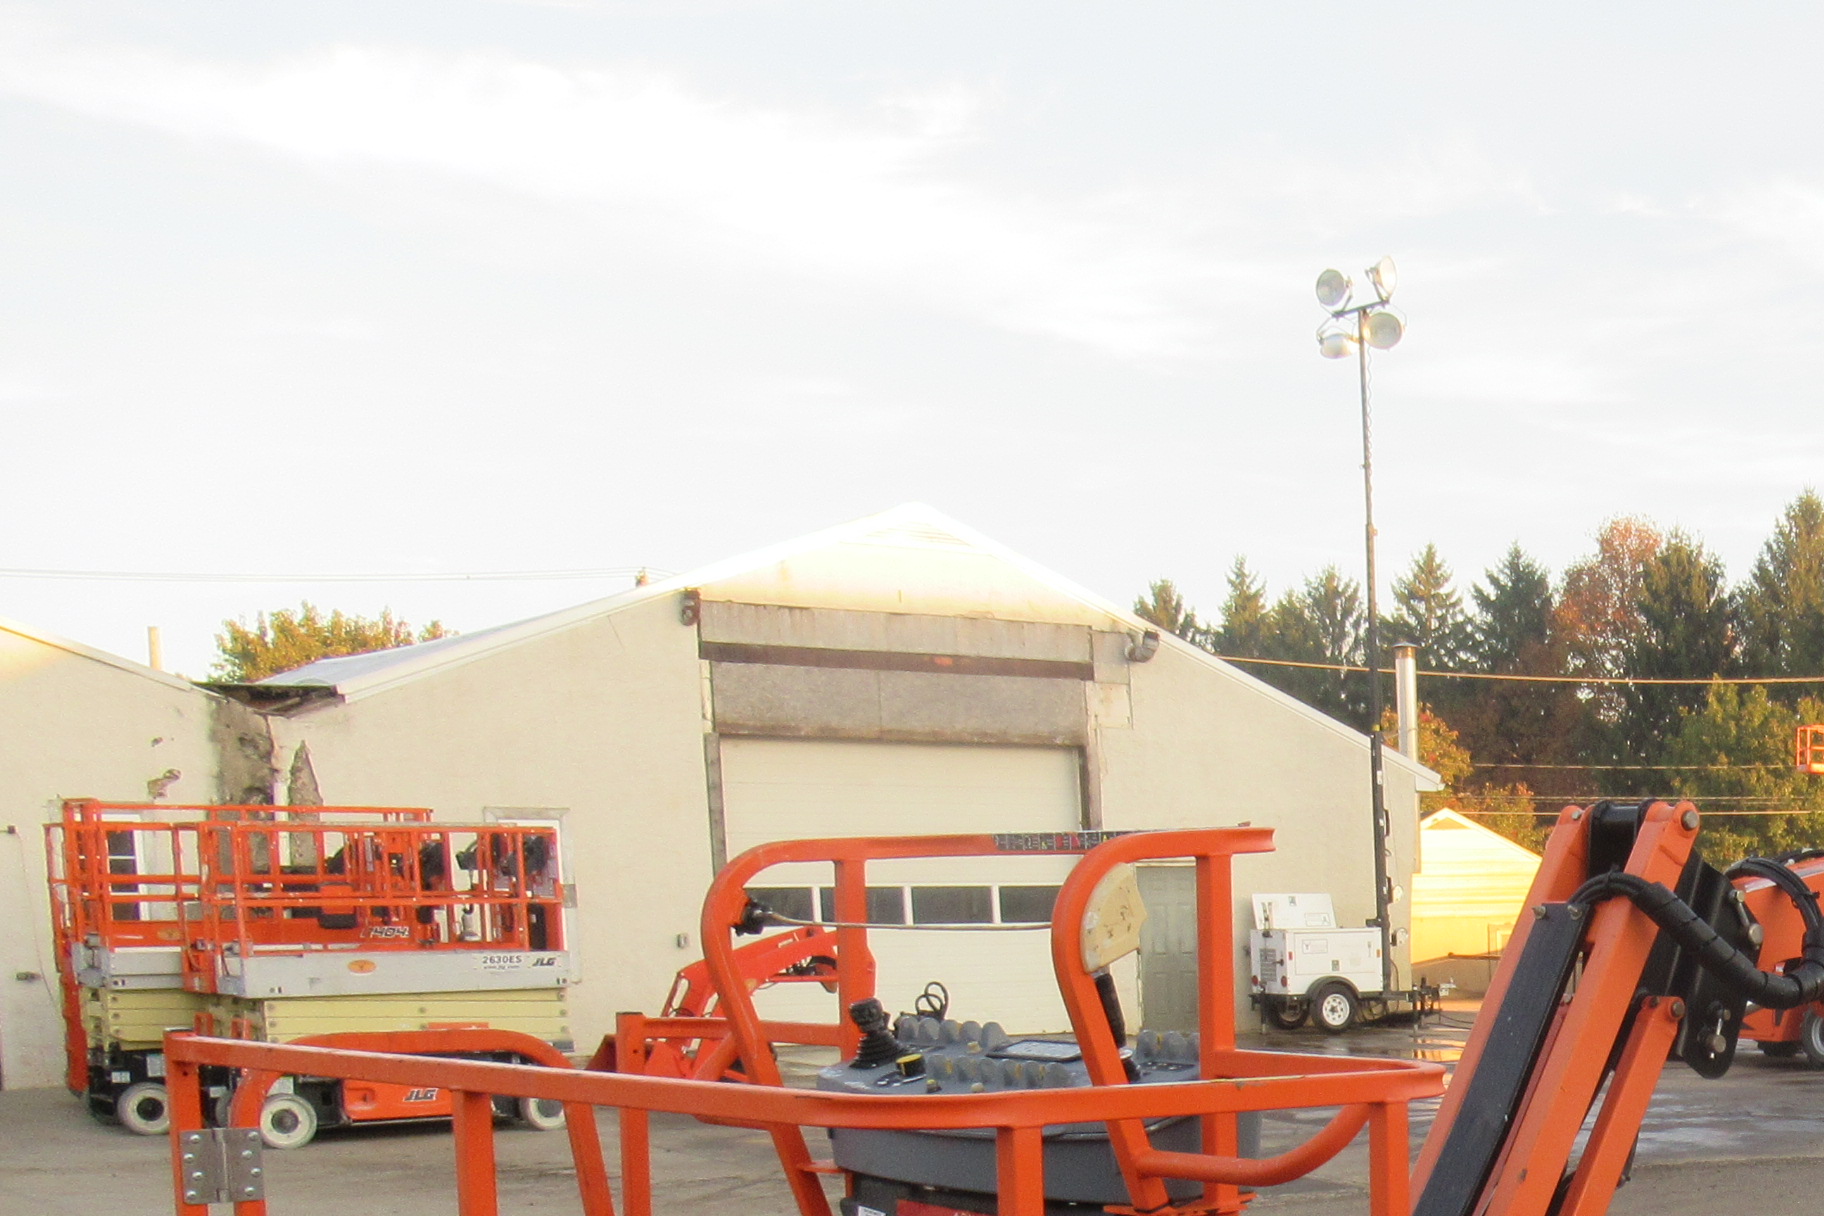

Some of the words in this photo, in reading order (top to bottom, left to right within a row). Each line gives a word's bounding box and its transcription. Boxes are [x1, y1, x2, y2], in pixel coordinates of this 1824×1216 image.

[482, 955, 522, 964] 2630ES
[532, 957, 557, 967] JLG
[404, 1088, 439, 1102] JLG
